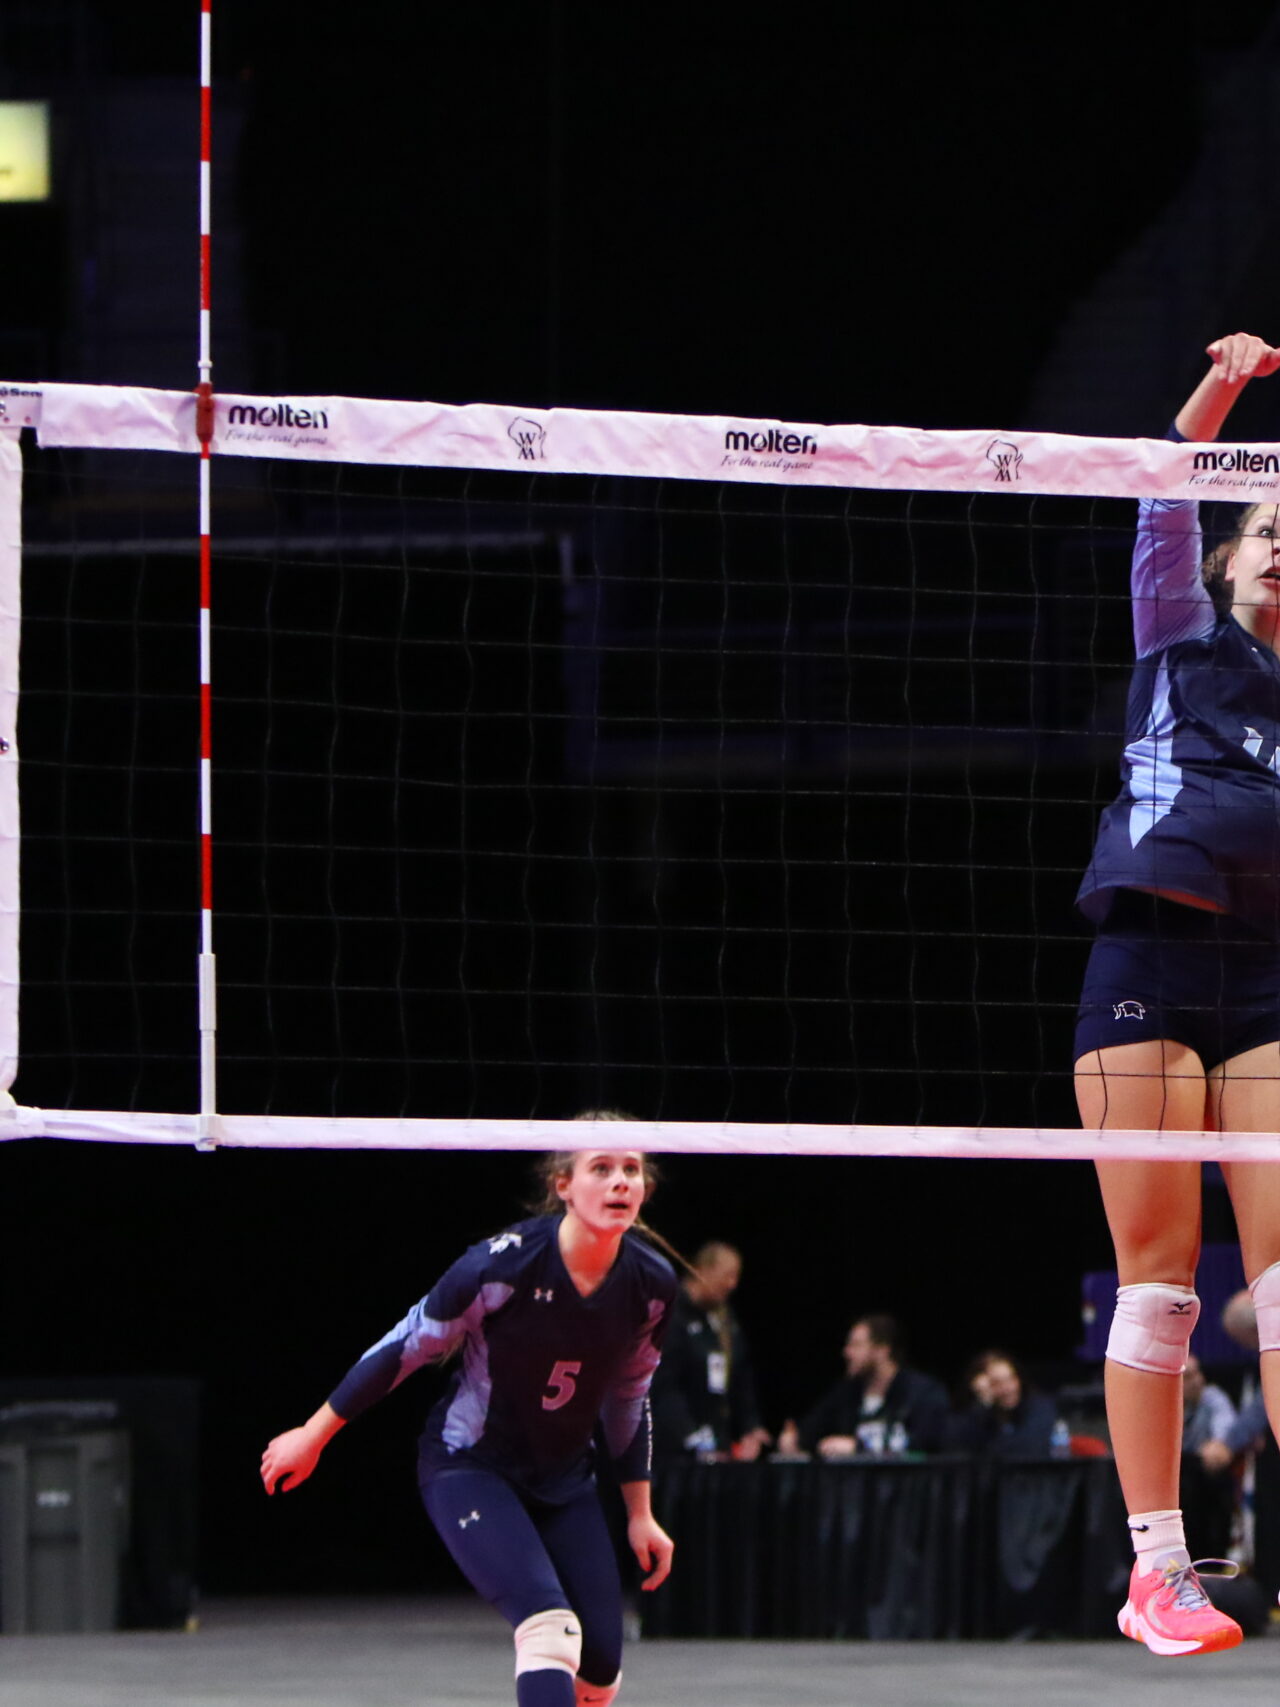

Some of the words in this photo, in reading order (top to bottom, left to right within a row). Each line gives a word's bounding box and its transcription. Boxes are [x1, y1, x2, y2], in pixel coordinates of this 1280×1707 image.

[228, 403, 328, 429] molten
[725, 429, 818, 454] molten
[738, 456, 758, 468] the
[782, 461, 814, 473] game
[1193, 449, 1280, 473] molten
[1189, 474, 1208, 486] For
[1208, 475, 1226, 486] the
[1227, 476, 1249, 487] real
[1249, 480, 1279, 491] game
[542, 1360, 582, 1411] 5
